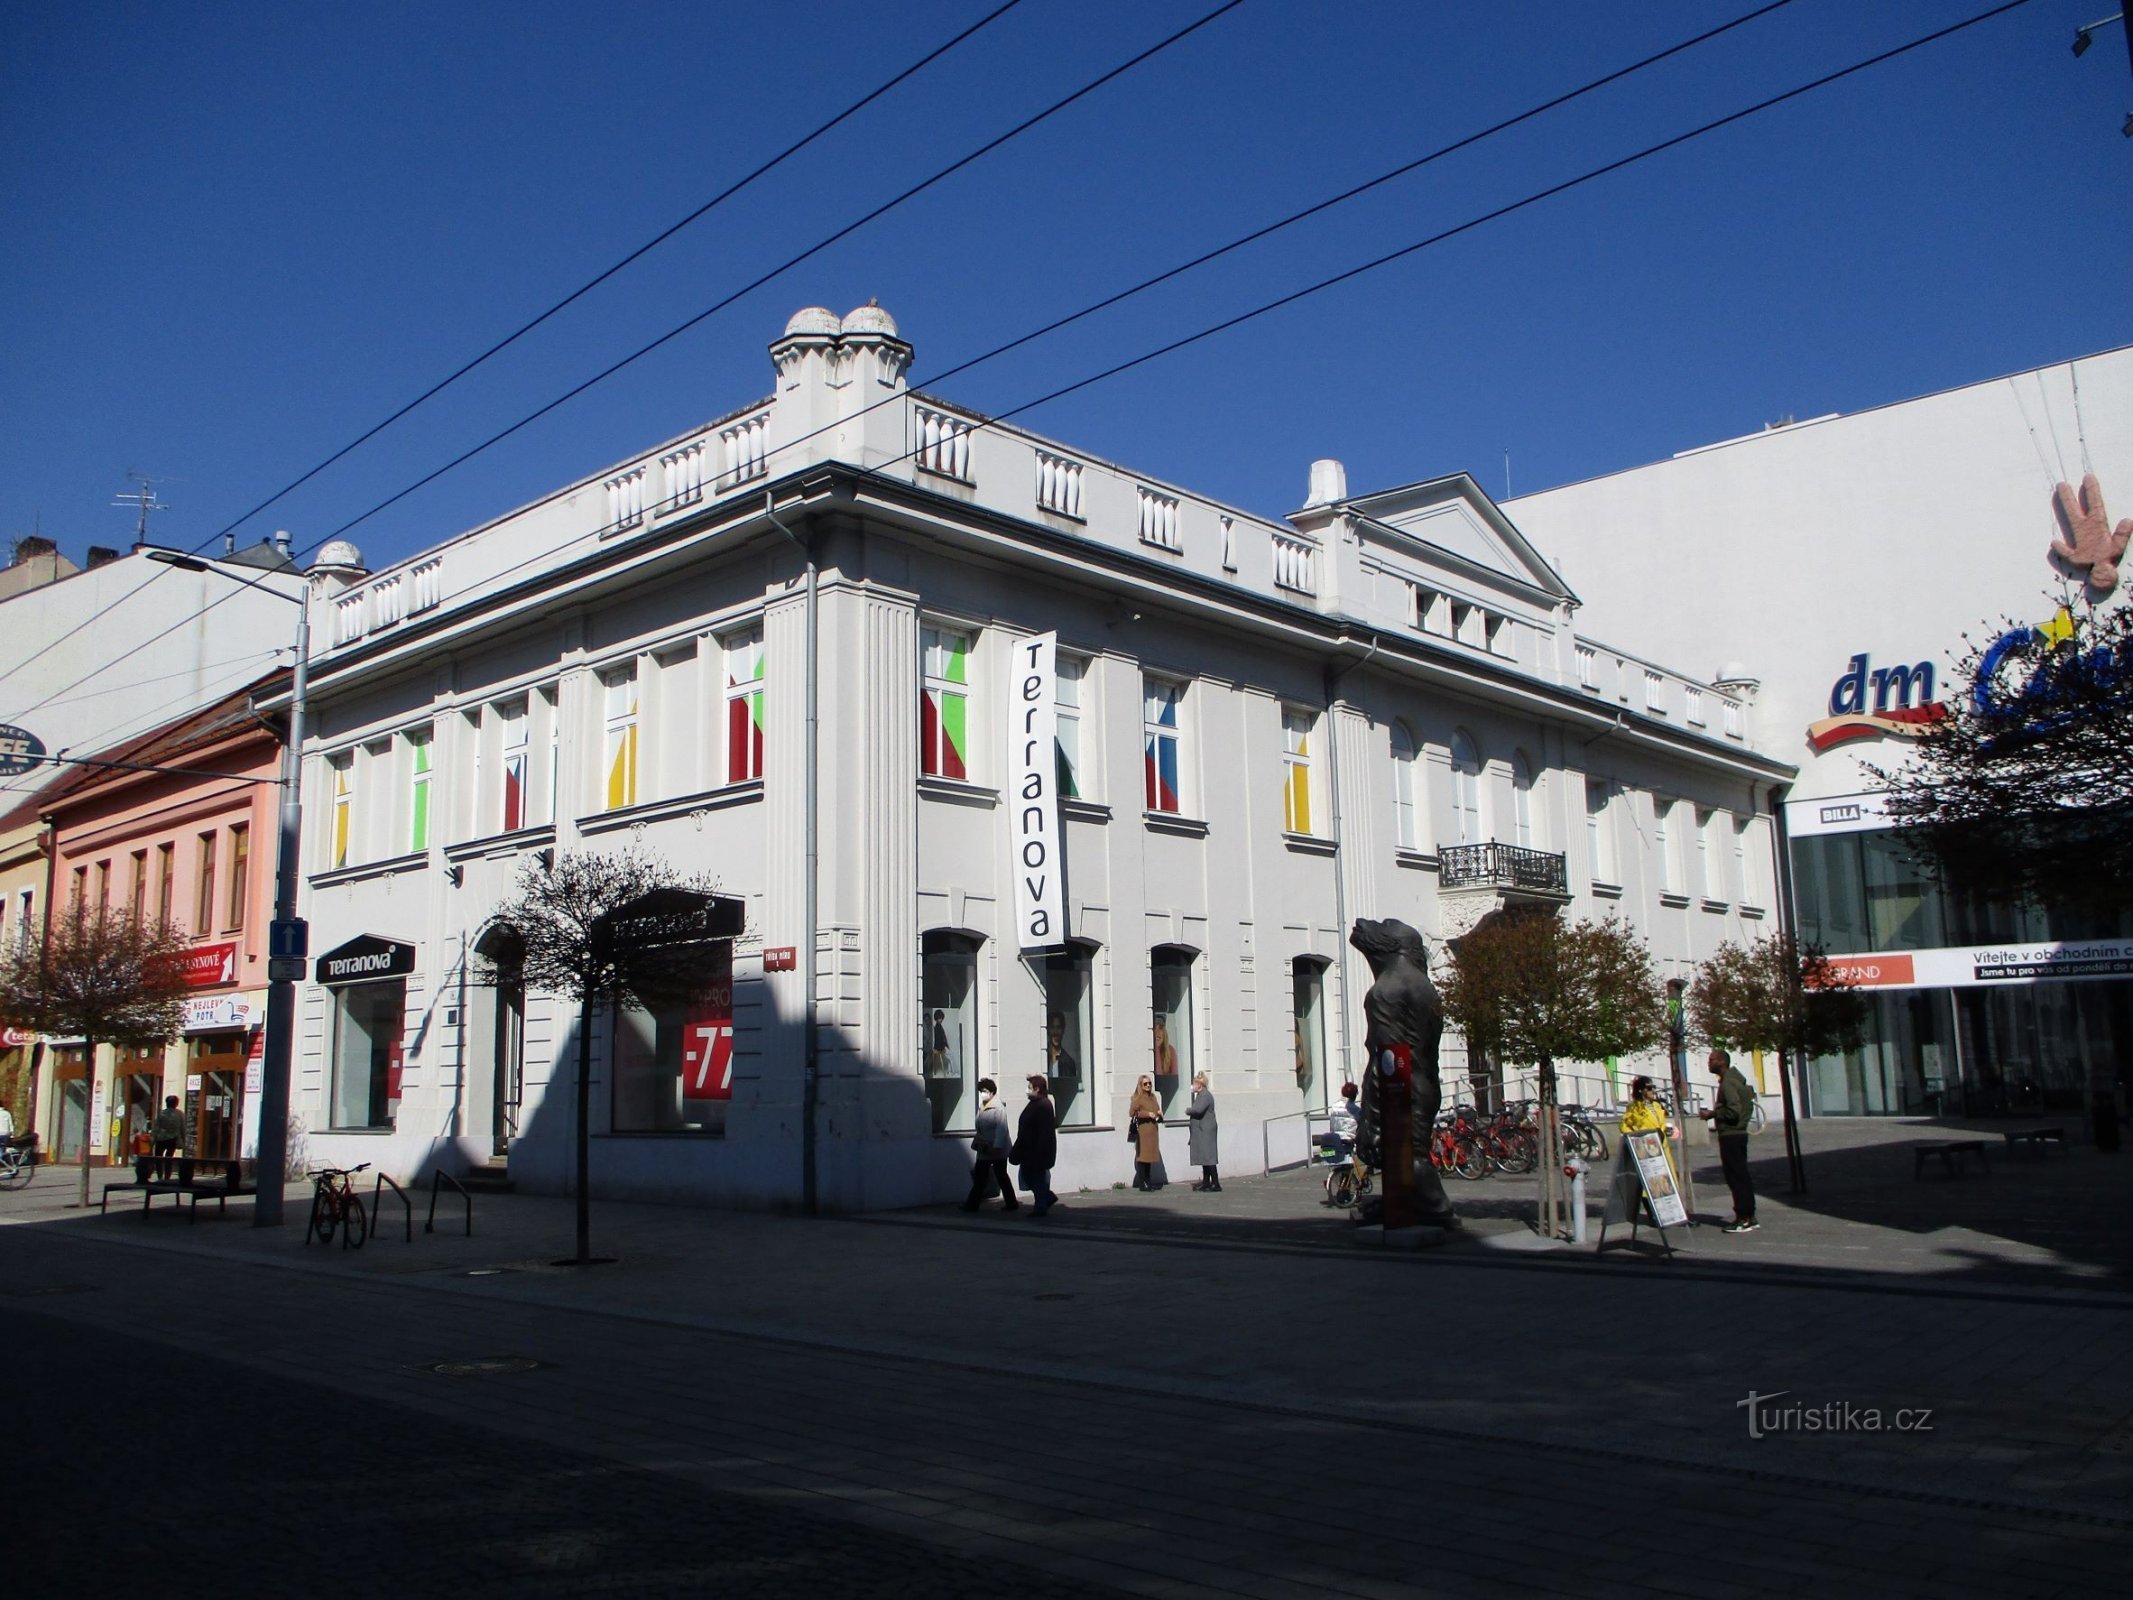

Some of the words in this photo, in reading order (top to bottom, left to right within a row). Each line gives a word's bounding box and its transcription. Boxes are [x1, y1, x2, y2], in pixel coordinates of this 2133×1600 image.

[1829, 652, 1936, 716] dm
[1022, 643, 1050, 936] Terranova
[1822, 807, 1859, 821] BILLA
[1973, 951, 2018, 965] Vítejte
[2021, 952, 2030, 961] v
[2033, 945, 2119, 960] obchodním
[1827, 965, 1880, 981] GRAND
[1980, 968, 2004, 977] Jsme
[2006, 967, 2016, 975] tu
[2018, 968, 2034, 977] pro
[2036, 964, 2054, 974] vás
[2056, 964, 2070, 974] od
[12, 1031, 35, 1042] teta
